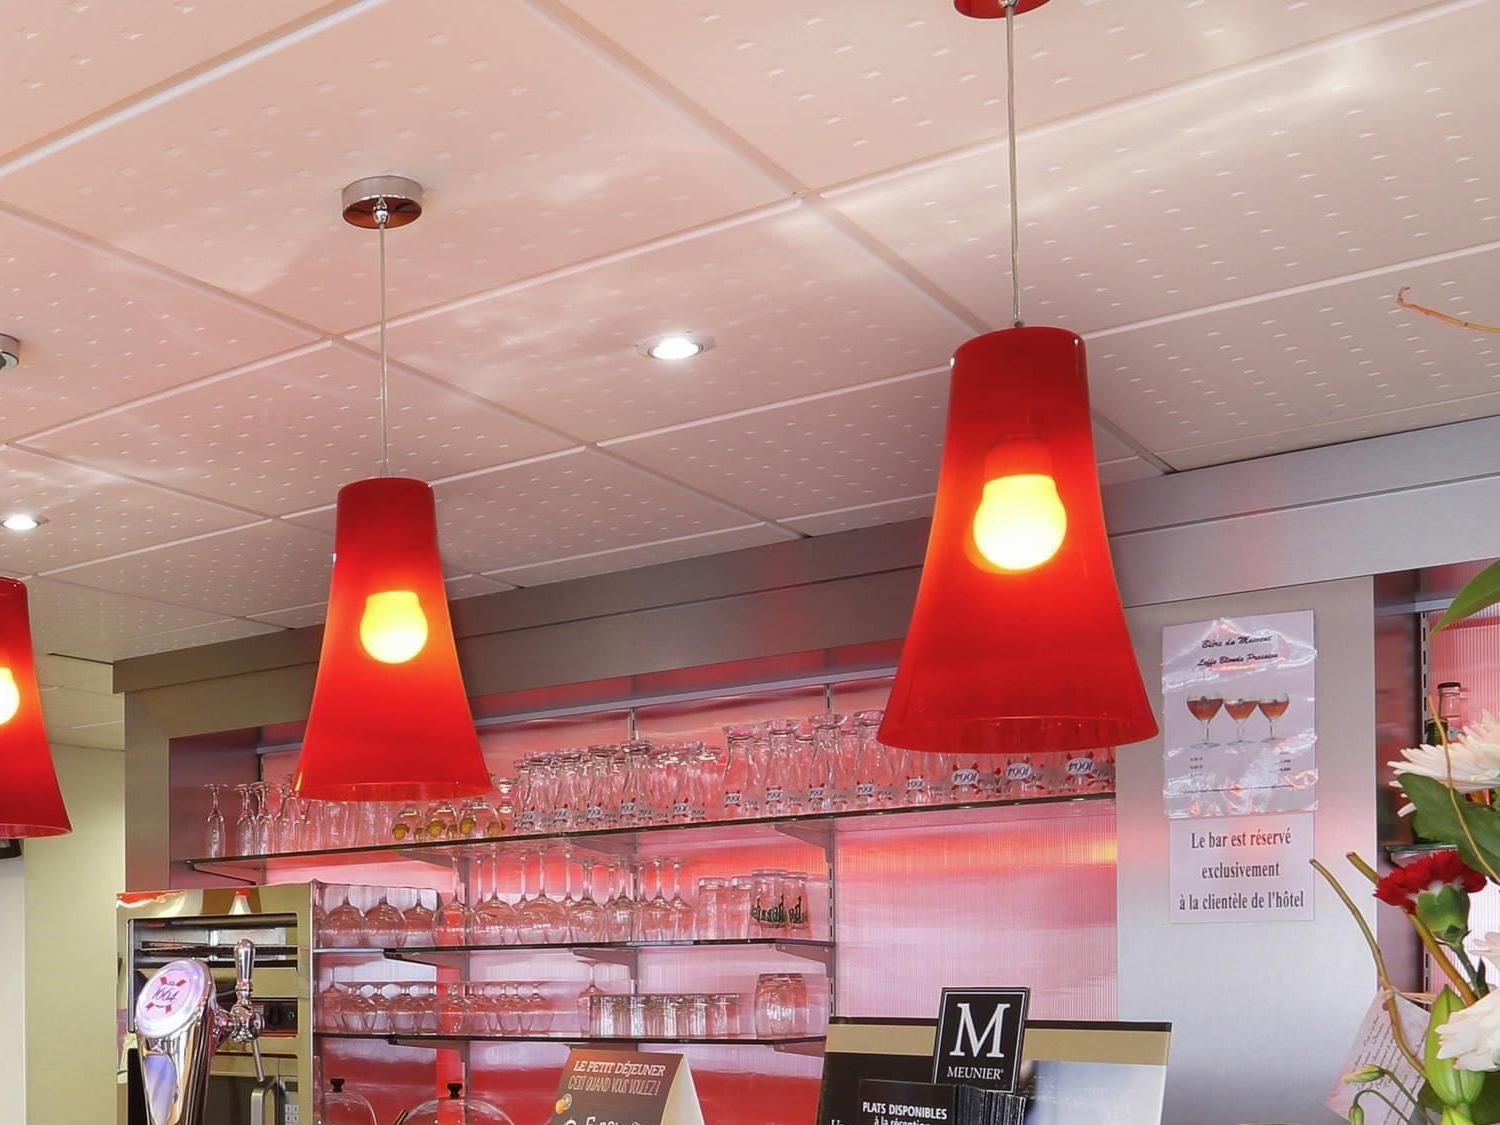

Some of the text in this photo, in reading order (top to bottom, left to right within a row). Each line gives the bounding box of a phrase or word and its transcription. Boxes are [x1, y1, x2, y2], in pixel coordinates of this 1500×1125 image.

[1068, 760, 1093, 773] 1664
[953, 773, 978, 785] 1664
[1191, 827, 1291, 849] Le bar est réservé
[1202, 862, 1280, 879] exclusivement
[1180, 890, 1304, 910] à la clientèle de l'hôtel
[950, 1003, 1011, 1058] M
[573, 1060, 666, 1077] LE PETIT DÉJEUNER
[586, 1076, 610, 1092] QUAND
[610, 1078, 629, 1094] VOUS
[862, 1101, 948, 1120] PLATS DISPONIBLES
